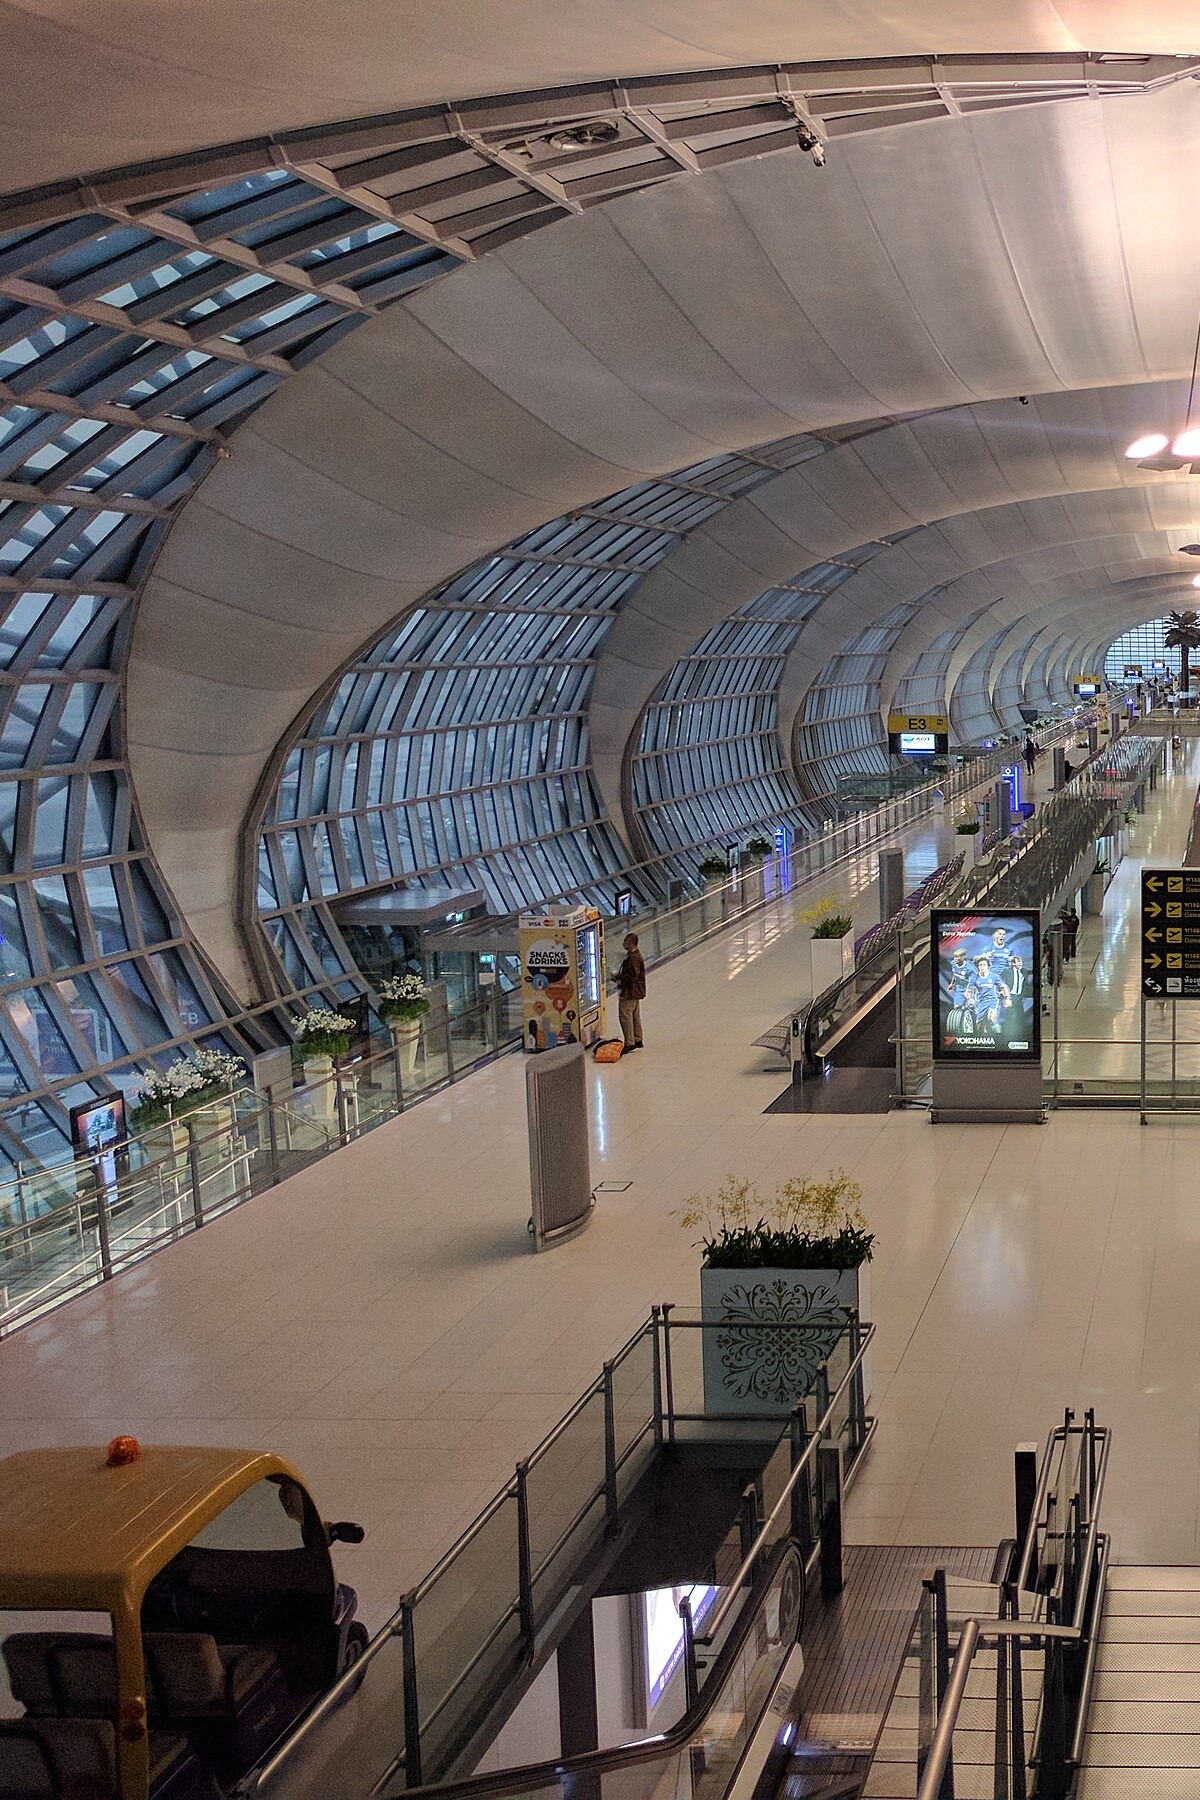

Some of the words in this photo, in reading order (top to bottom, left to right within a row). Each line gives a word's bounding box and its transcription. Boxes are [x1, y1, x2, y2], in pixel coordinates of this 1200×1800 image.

[908, 718, 927, 730] E3
[529, 951, 566, 959] SNACKS
[956, 1037, 996, 1045] YOKOHAMA
